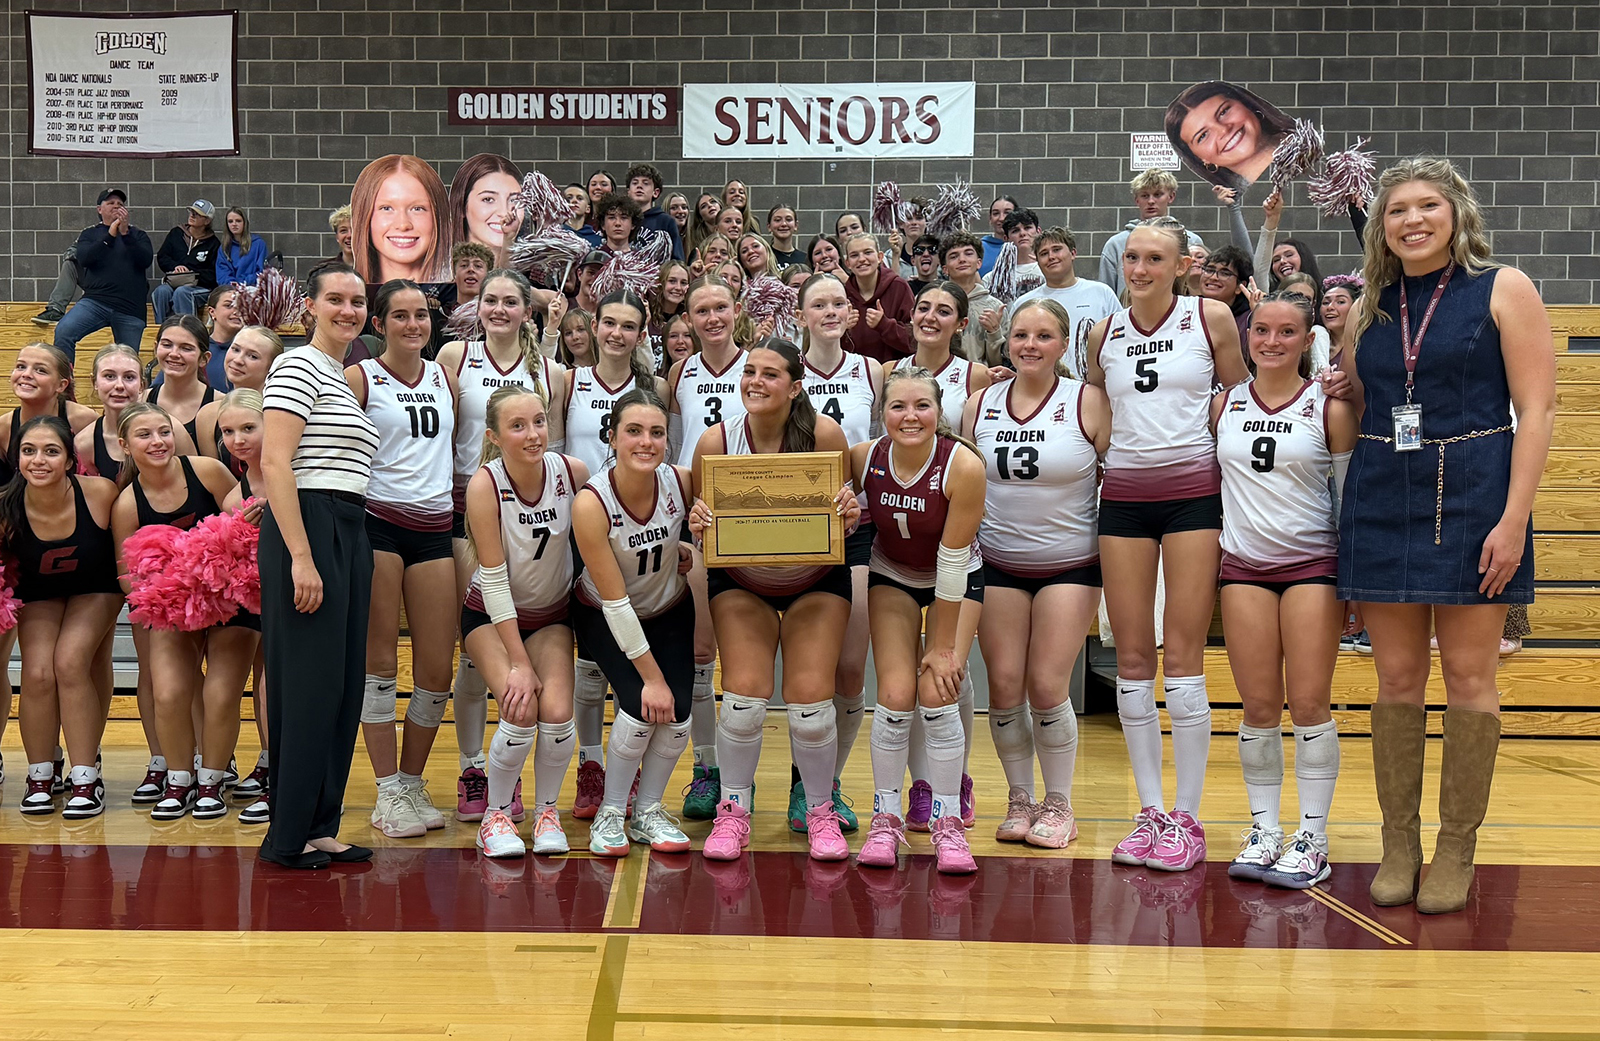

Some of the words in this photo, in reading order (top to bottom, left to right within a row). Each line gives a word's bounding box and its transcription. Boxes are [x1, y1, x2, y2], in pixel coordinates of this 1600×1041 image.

[94, 31, 167, 55] GOLDEN
[110, 60, 131, 69] DANCE
[137, 60, 155, 69] TEAM
[60, 73, 79, 83] DANCE
[82, 73, 113, 84] NATIONALS
[158, 74, 177, 84] STATE
[180, 72, 220, 84] RUNNERS-UP
[45, 87, 75, 97] 2004-5TH
[77, 88, 94, 97] PLACE
[95, 89, 109, 98] JAZZ
[110, 89, 131, 98] DIVISION
[161, 89, 178, 98] 2009
[77, 99, 94, 109] PLACE
[96, 100, 109, 109] TEAM
[110, 100, 144, 110] PERFORMANCE
[161, 97, 178, 106] 2012
[457, 92, 545, 120] GOLDEN
[549, 92, 668, 120] STUDENTS
[77, 111, 94, 120] PLACE
[96, 111, 117, 121] HIP-HOP
[118, 112, 139, 121] DIVISION
[713, 94, 943, 147] SENIORS
[78, 123, 95, 132] PLACE
[97, 124, 117, 133] HIP-HOP
[118, 124, 139, 133] DIVISION
[78, 134, 95, 144] PLACE
[99, 135, 113, 144] JAZZ
[116, 135, 139, 144] DIVISION
[1126, 339, 1173, 357] GOLDEN
[482, 377, 524, 388] GOLDEN
[1134, 357, 1158, 393] 5
[697, 383, 735, 394] GOLDEN
[808, 383, 849, 395] GOLDEN
[396, 393, 436, 403] GOLDEN
[704, 396, 722, 427] 3
[821, 397, 844, 425] 4
[405, 405, 440, 438] 10
[1242, 420, 1293, 434] GOLDEN
[995, 430, 1045, 442] GOLDEN
[1250, 436, 1277, 473] 9
[994, 446, 1039, 480] 13
[880, 491, 926, 512] GOLDEN
[893, 512, 911, 539] 1
[532, 526, 551, 561] 7
[628, 525, 669, 548] GOLDEN
[39, 545, 79, 575] G
[636, 543, 663, 576] 11
